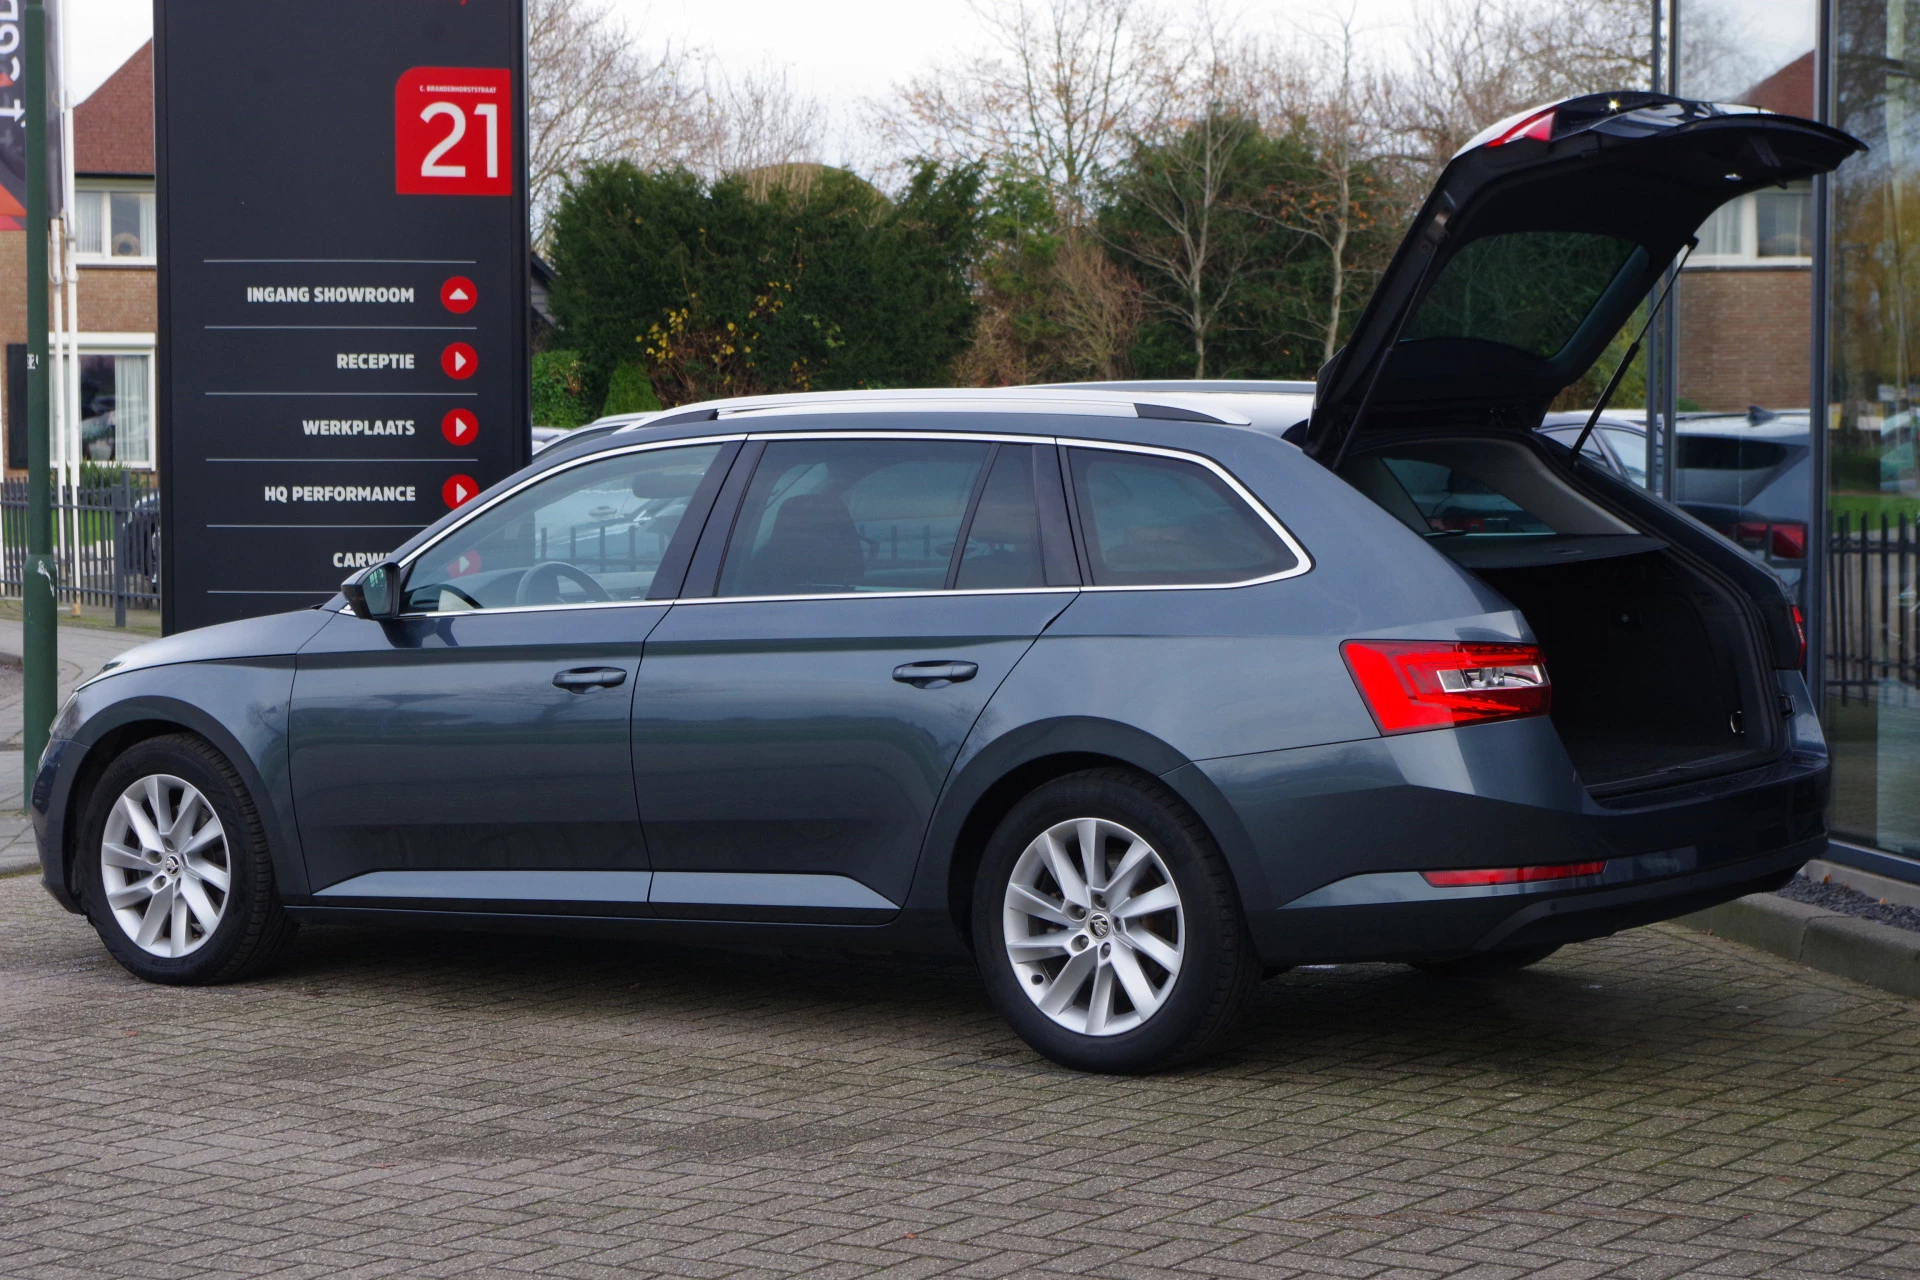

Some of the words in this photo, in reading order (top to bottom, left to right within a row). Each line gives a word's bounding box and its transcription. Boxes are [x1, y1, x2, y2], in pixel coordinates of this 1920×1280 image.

[419, 84, 425, 92] C.
[420, 101, 498, 178] 21
[247, 287, 310, 303] INGANG
[313, 287, 415, 303] SHOWROOM
[336, 353, 415, 369] RECEPTIE
[302, 420, 415, 436] WERKPLAATS
[264, 486, 287, 504] HQ
[292, 486, 416, 503] PERFORMANCE
